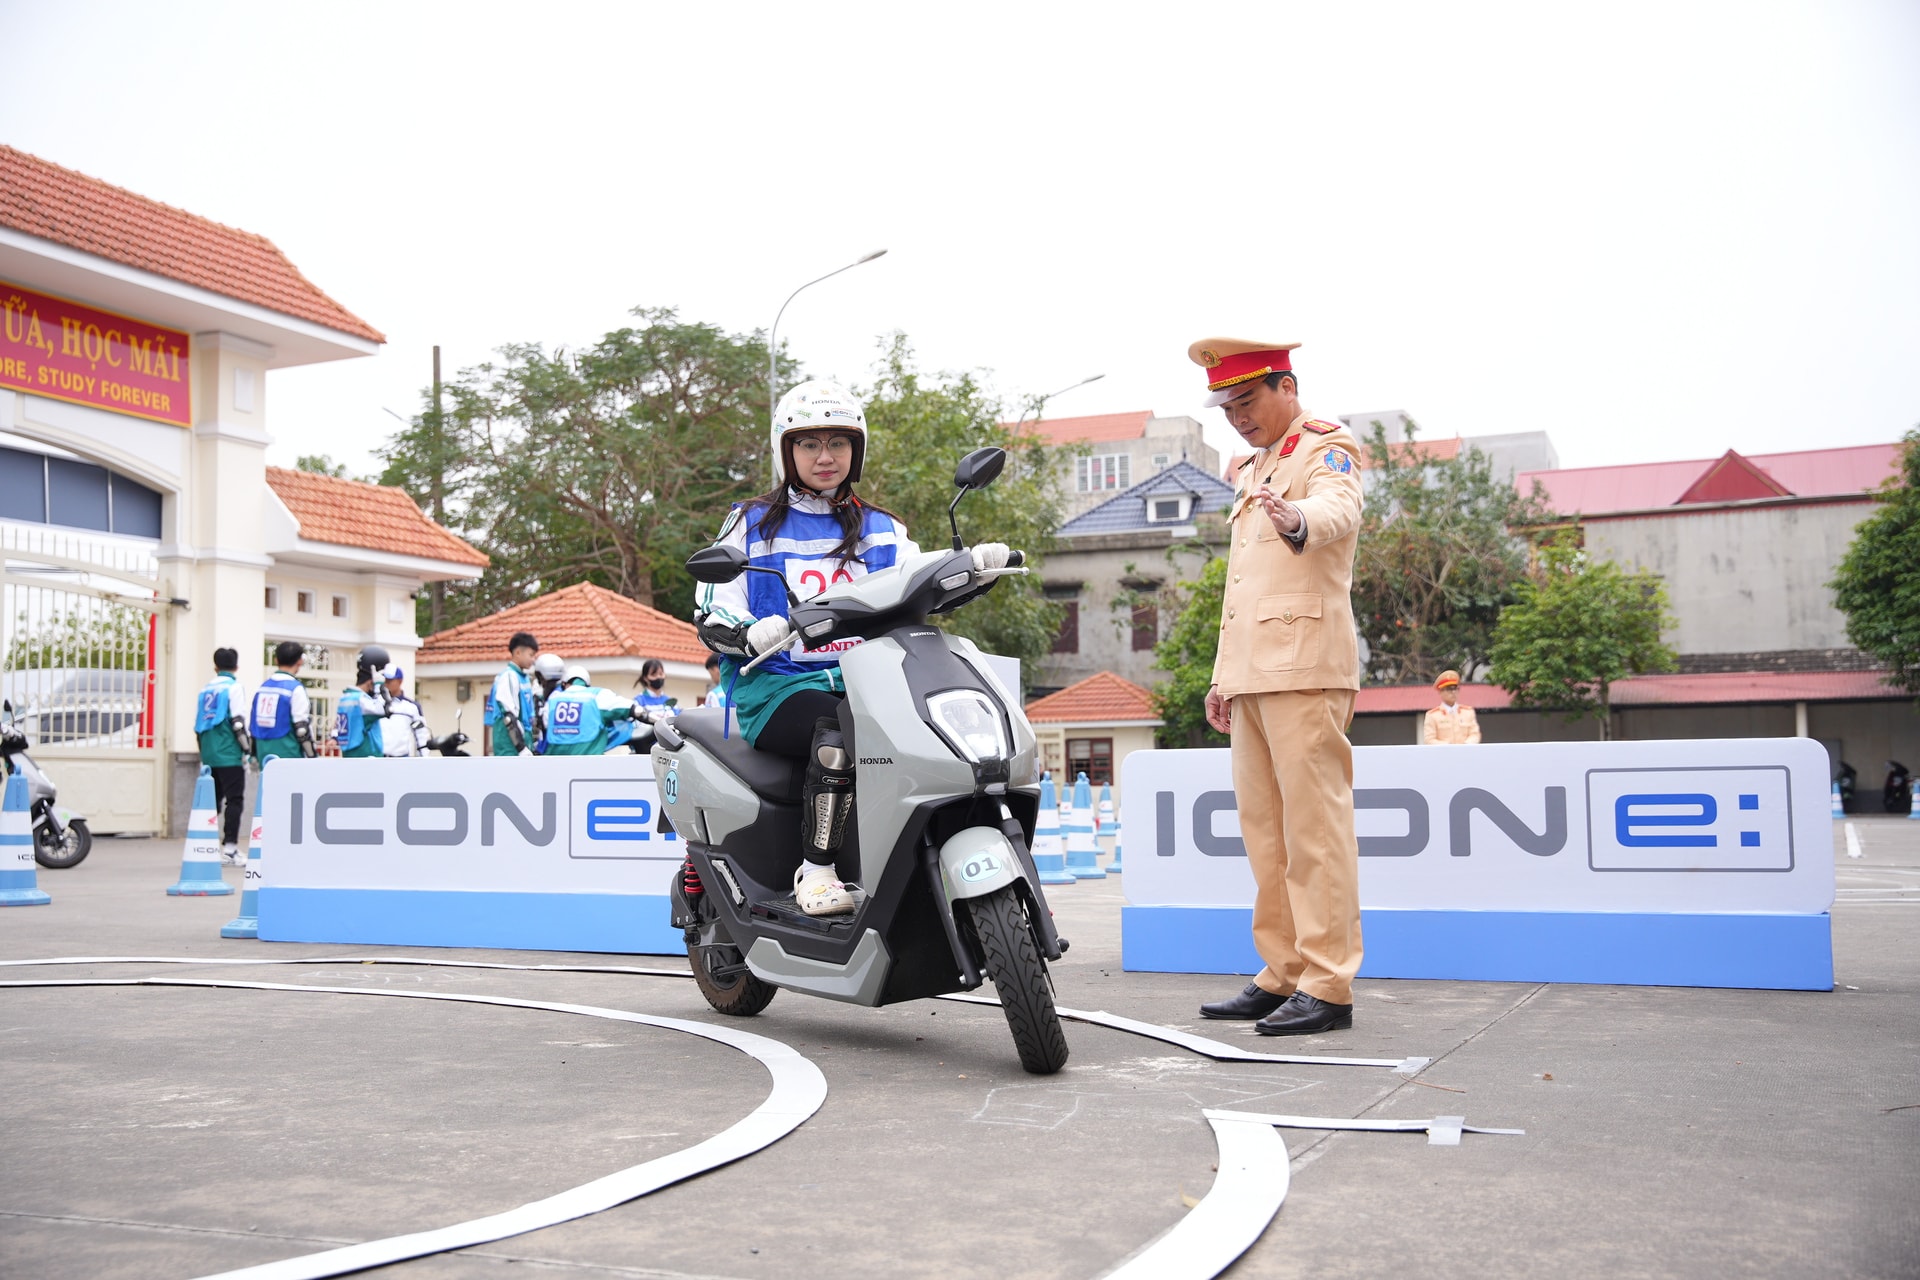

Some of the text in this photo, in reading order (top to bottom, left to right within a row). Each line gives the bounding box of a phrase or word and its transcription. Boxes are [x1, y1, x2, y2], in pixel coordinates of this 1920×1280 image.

[0, 294, 181, 382] ỮA, HỌC MÃI
[0, 357, 171, 412] RE, STUDY FOREVER
[555, 702, 580, 723] 65
[859, 757, 894, 765] HONDA
[666, 777, 677, 797] 01
[290, 792, 557, 847] ICON
[965, 857, 999, 878] 01
